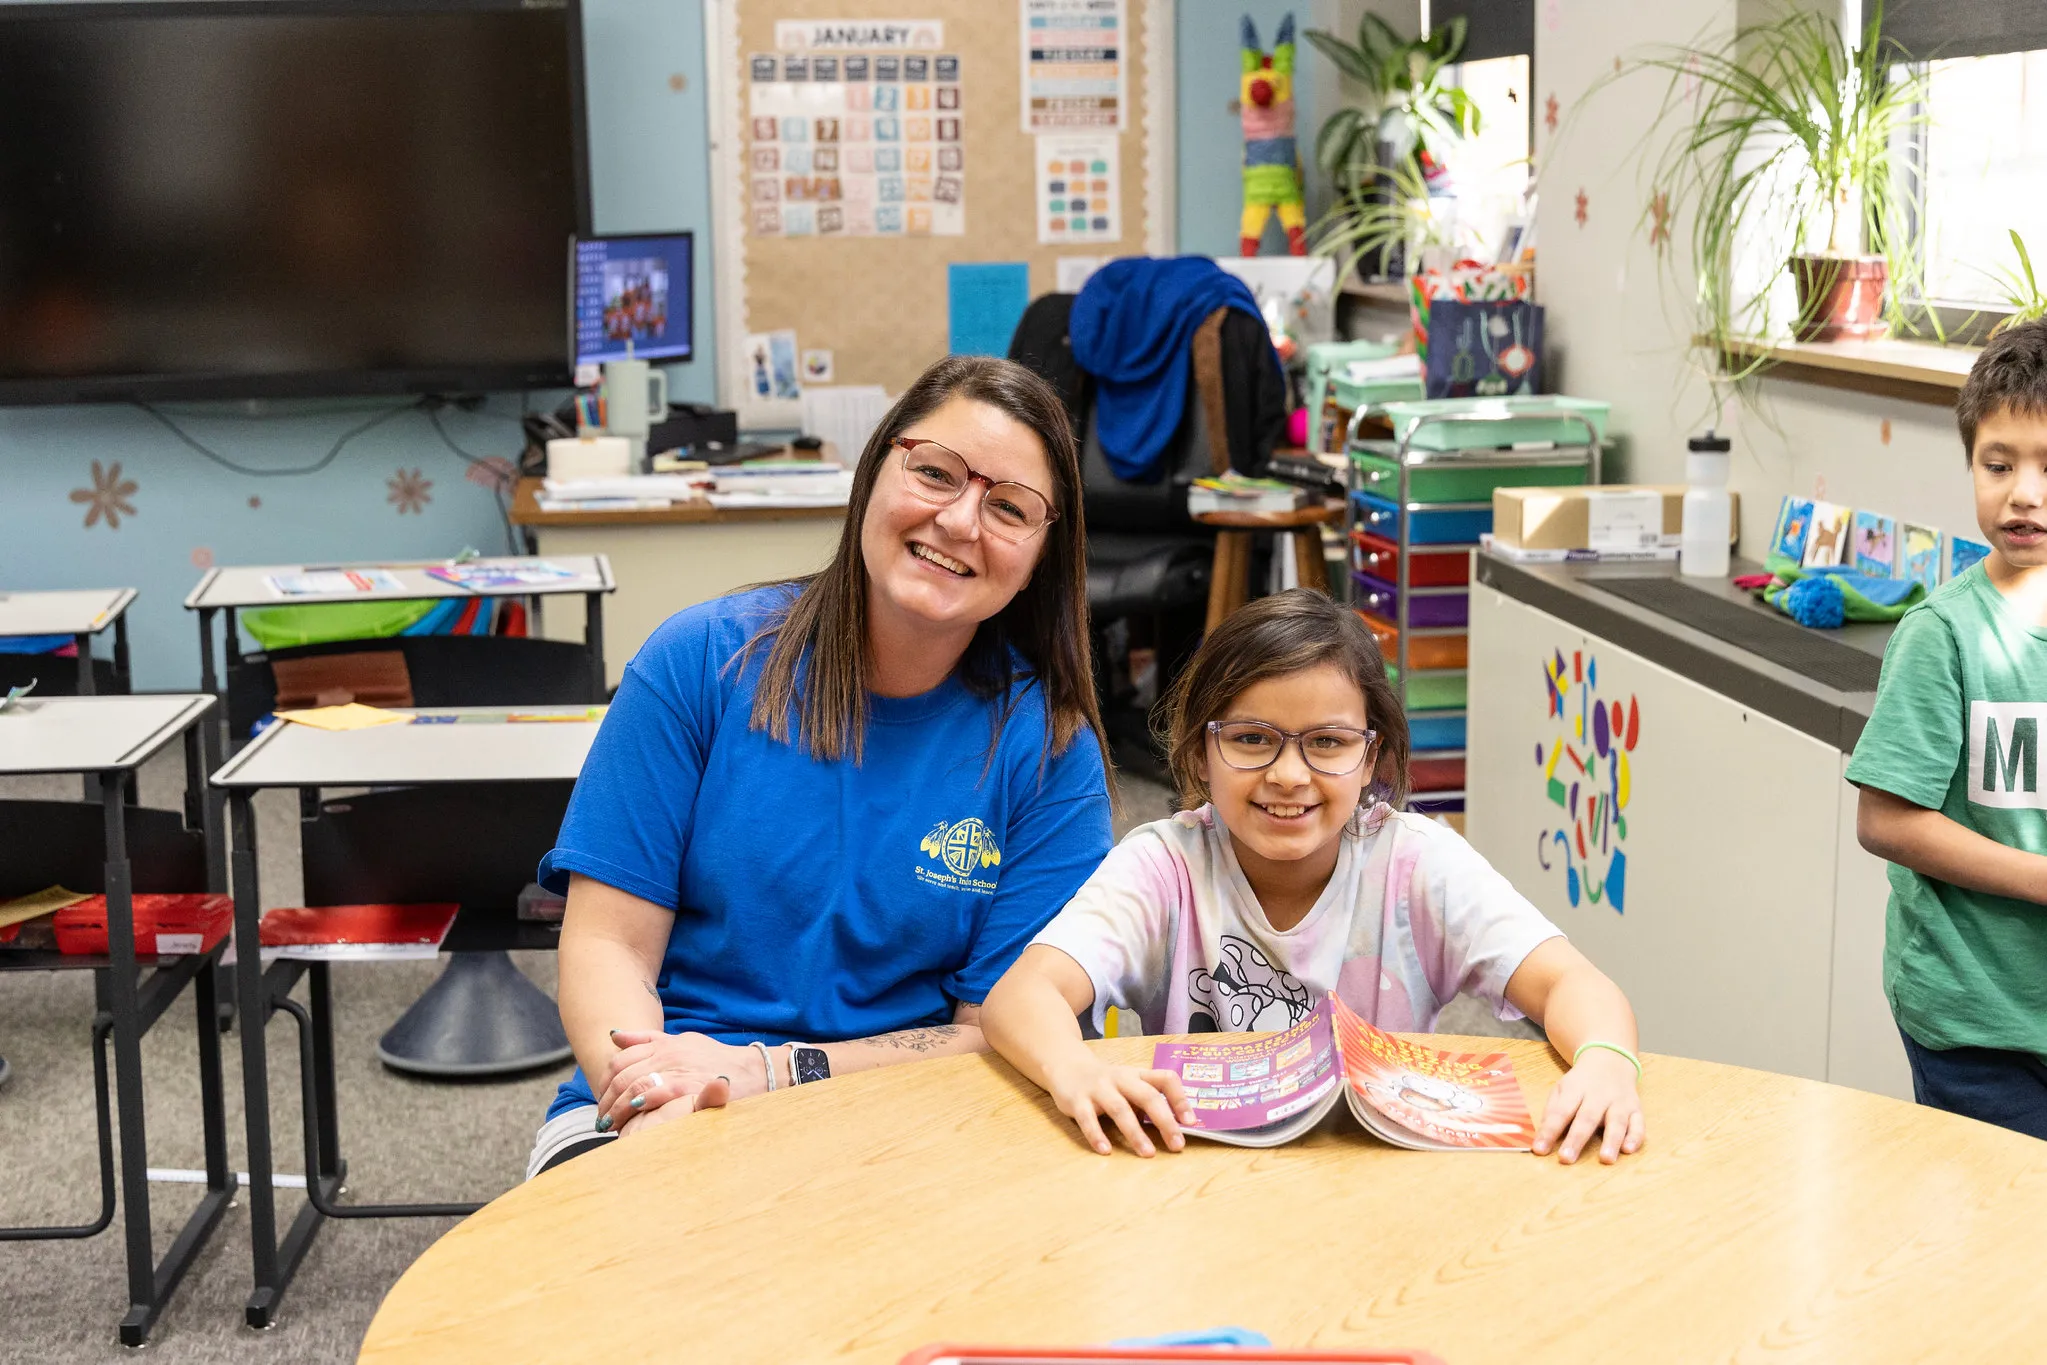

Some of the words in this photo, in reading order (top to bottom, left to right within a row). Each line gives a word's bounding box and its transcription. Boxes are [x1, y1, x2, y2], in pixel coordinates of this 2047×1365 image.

[813, 27, 910, 46] JANUARY
[914, 865, 926, 875] St.
[926, 869, 957, 883] Joseph's
[1203, 1049, 1231, 1057] GUY
